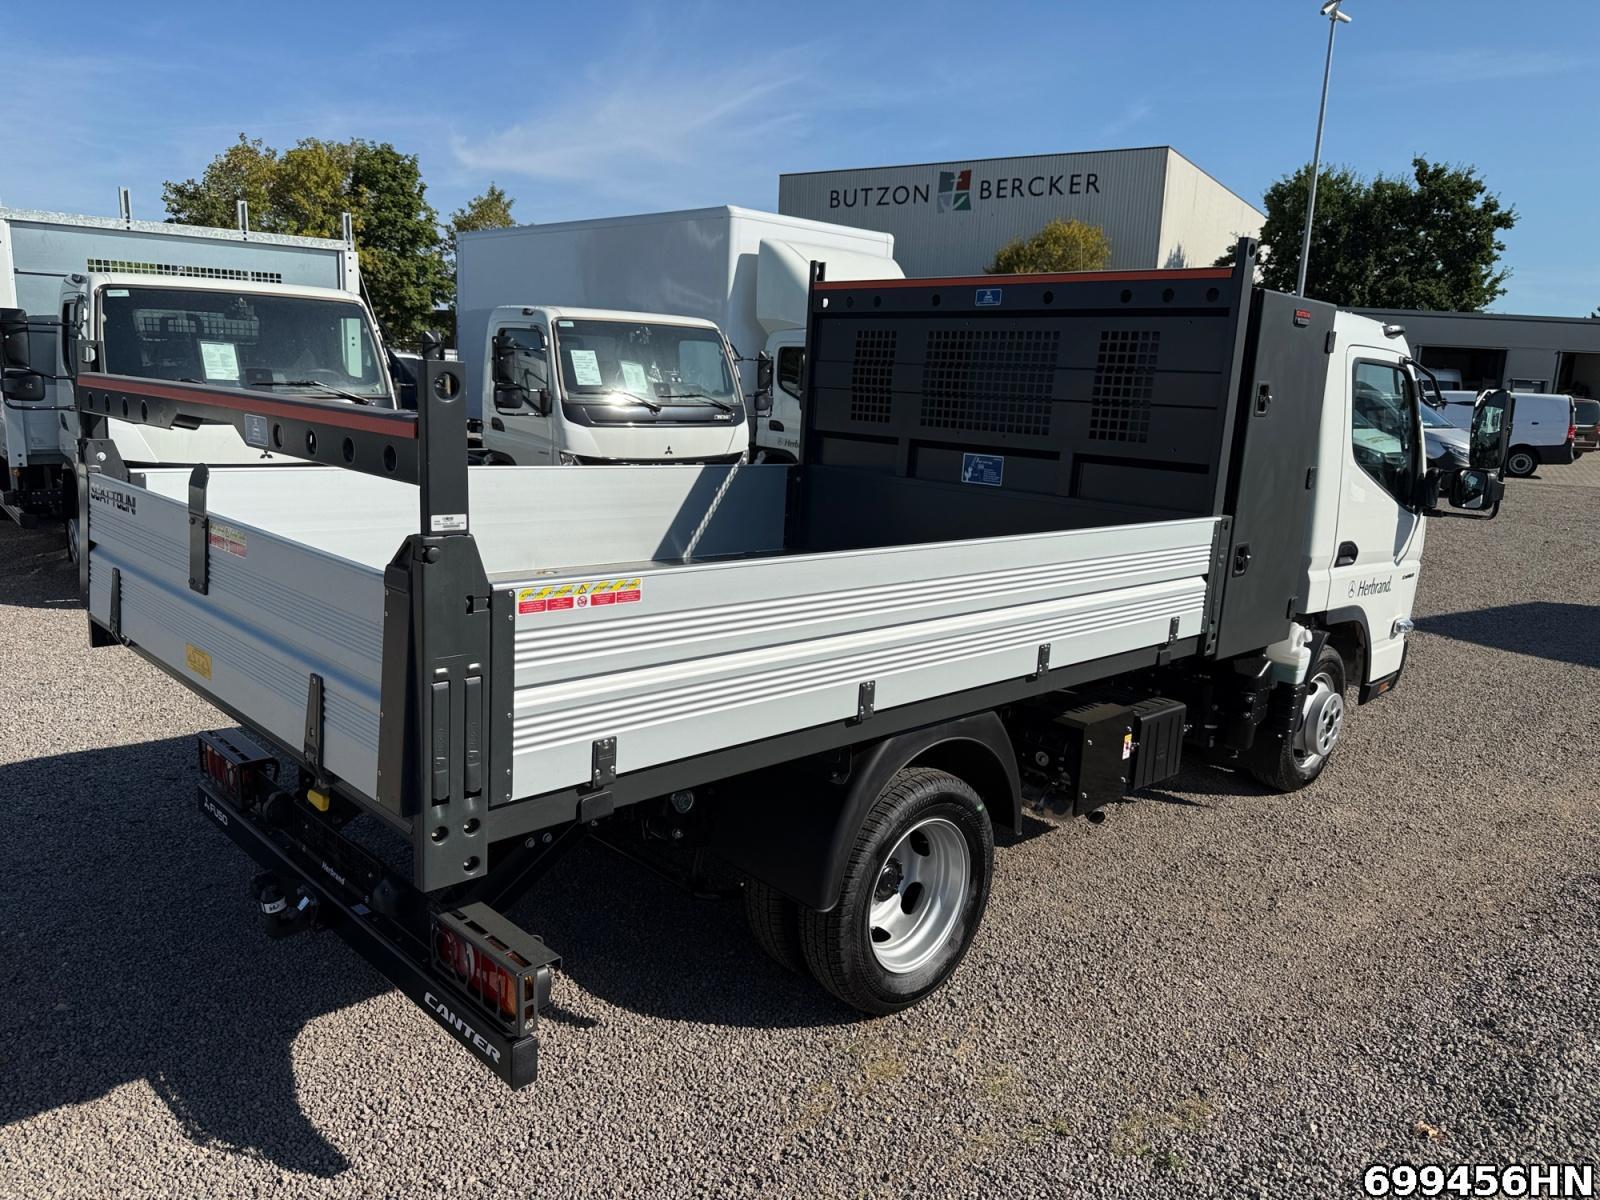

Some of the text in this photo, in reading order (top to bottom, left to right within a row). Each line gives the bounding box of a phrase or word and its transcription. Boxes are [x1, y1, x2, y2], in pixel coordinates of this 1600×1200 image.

[829, 173, 1101, 209] BUTZON BERCKER
[209, 802, 228, 827] FUSO
[424, 991, 501, 1064] CANTER
